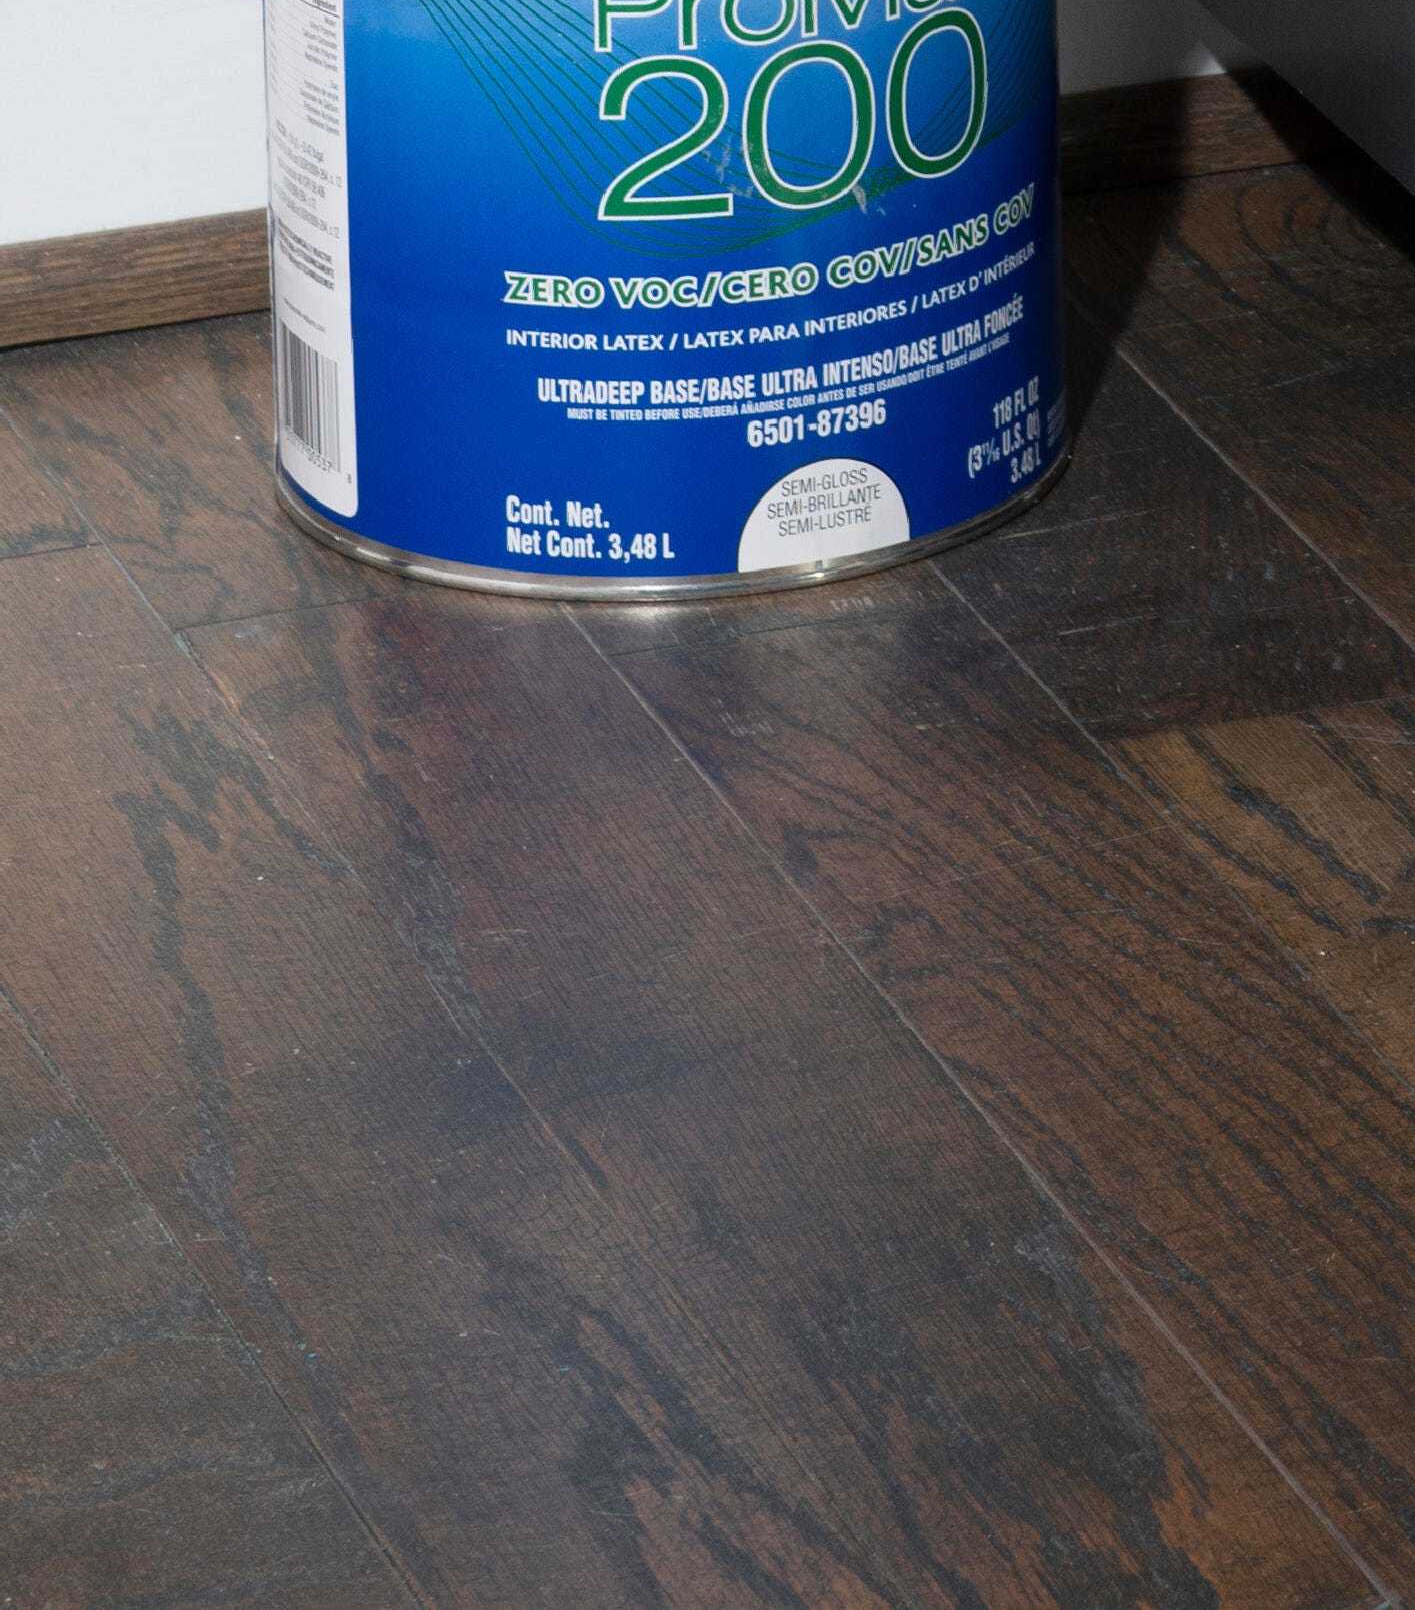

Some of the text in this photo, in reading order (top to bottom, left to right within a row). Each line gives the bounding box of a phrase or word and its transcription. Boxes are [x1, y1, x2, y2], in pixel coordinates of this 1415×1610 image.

[597, 7, 988, 221] 200
[503, 182, 1035, 310] ZERO VOC/CERO COV/SANS COV
[506, 329, 599, 351] INTERIOR
[603, 333, 664, 351] LATEX
[683, 329, 744, 350] LATEX
[749, 324, 800, 344] PARA
[804, 299, 907, 337] INTERIORES
[922, 280, 967, 310] LATEX
[968, 241, 1036, 293] D'INTÉRIEUR
[537, 292, 1024, 405] ULTRADEEP BASE/BASE ULTRA INTENSO/BASE ULTRA FONCÉE
[567, 407, 594, 420] MUST
[596, 408, 608, 420] BE
[610, 408, 643, 421] TINTED
[645, 407, 680, 421] BEFORE
[682, 401, 739, 420] USE/DEBERÁ
[740, 398, 785, 416] AÑADIRSE
[787, 394, 815, 410] COLOR
[817, 389, 844, 404] ANTES
[846, 386, 857, 399] DE
[858, 383, 875, 397] SER
[926, 362, 945, 379] ÊTRE
[992, 375, 1040, 429] 118 FL OZ
[747, 398, 887, 448] 6501-87396
[1002, 423, 1025, 456] U.S.
[781, 467, 868, 497] SEMI-GLOSS
[1011, 449, 1034, 484] 3.48
[506, 494, 610, 529] Cont. Net.
[767, 483, 882, 520] SEMI-BRILLANTE
[778, 503, 872, 538] SEMI-LUSTRÉ
[506, 526, 675, 564] Net Cont. 3,48 L
